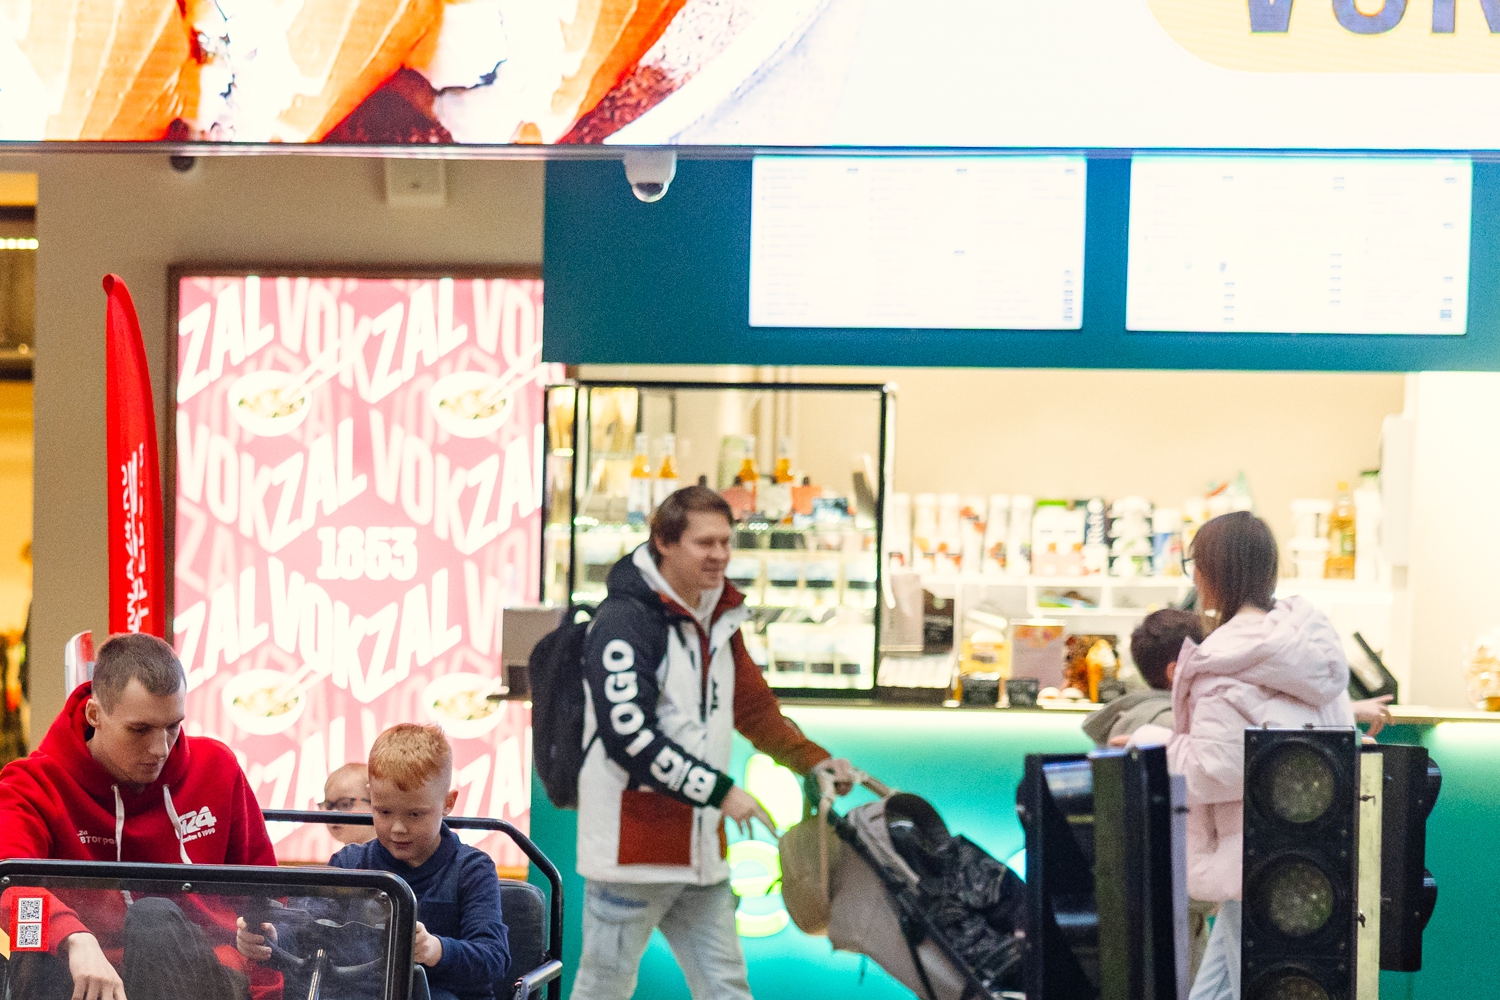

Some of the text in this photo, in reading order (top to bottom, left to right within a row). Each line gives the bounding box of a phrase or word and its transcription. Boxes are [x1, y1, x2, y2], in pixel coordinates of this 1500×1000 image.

[176, 408, 367, 553] VOKZAL
[268, 556, 462, 704] VOKZAL
[651, 745, 717, 803] BIG
